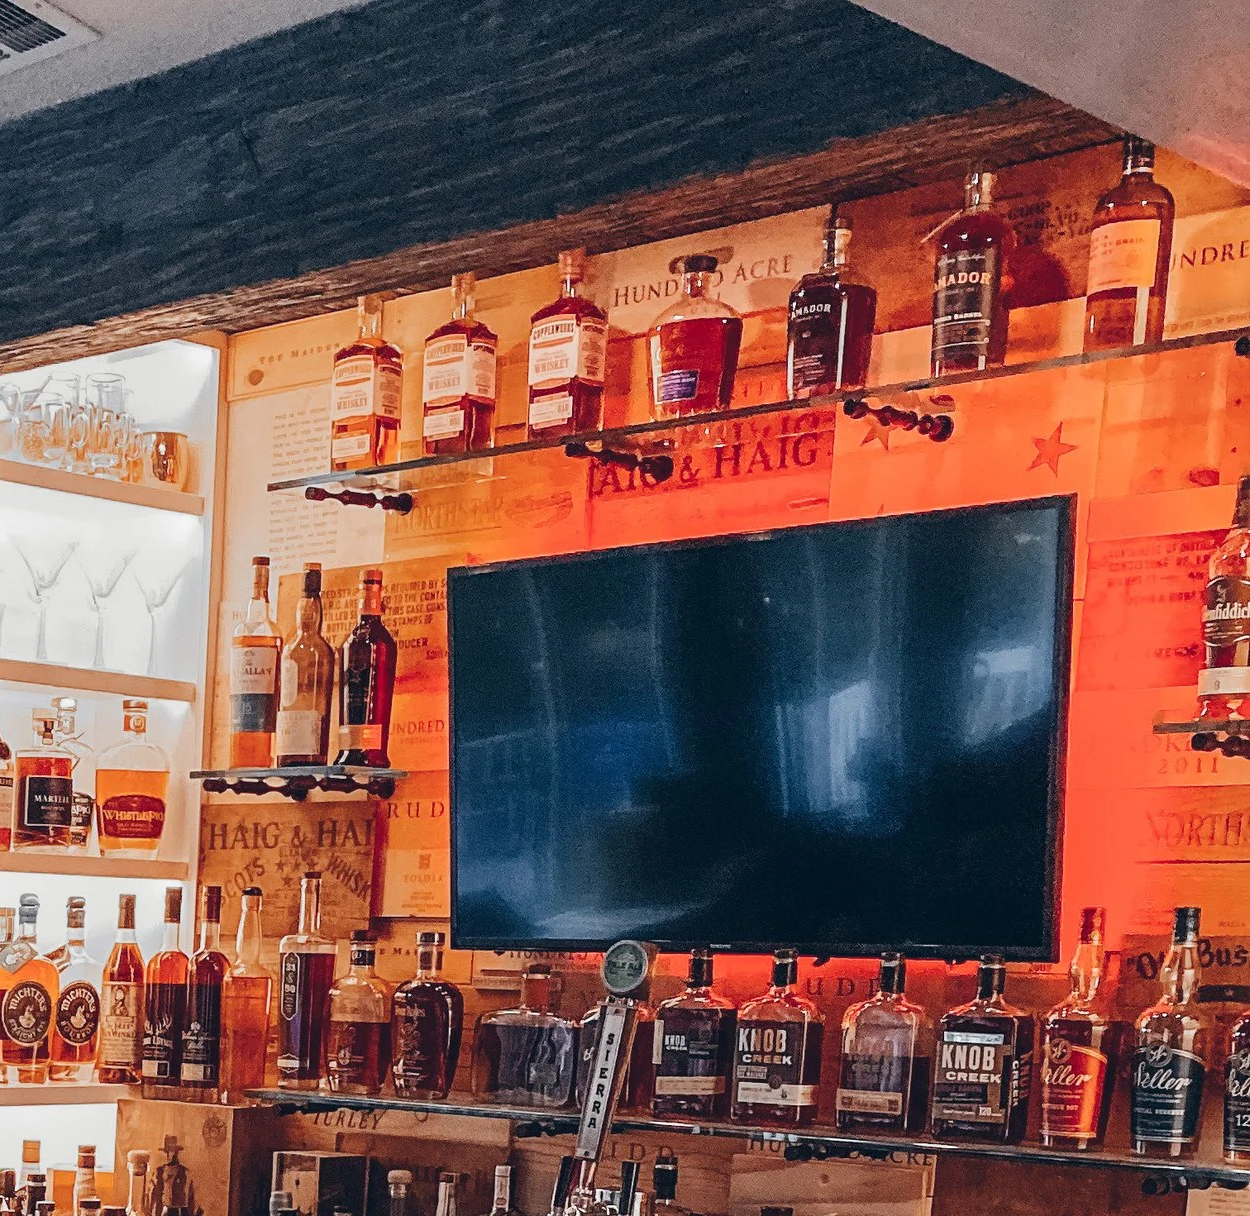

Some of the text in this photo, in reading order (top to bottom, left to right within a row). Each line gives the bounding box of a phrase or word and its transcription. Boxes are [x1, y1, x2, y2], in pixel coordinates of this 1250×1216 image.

[732, 254, 794, 284] ACRE
[714, 435, 819, 479] HAIG
[387, 801, 445, 818] RUD
[208, 821, 281, 850] HAIG
[224, 856, 266, 898] COTS
[664, 1034, 686, 1046] KNOB
[738, 1027, 786, 1052] KNOB
[742, 1055, 792, 1065] CREEK
[942, 1044, 996, 1071] KNOB
[587, 1032, 616, 1130] SIERRA
[945, 1071, 1001, 1084] CREEK
[1134, 1062, 1193, 1091] Weller
[312, 1109, 384, 1131] TURLEY
